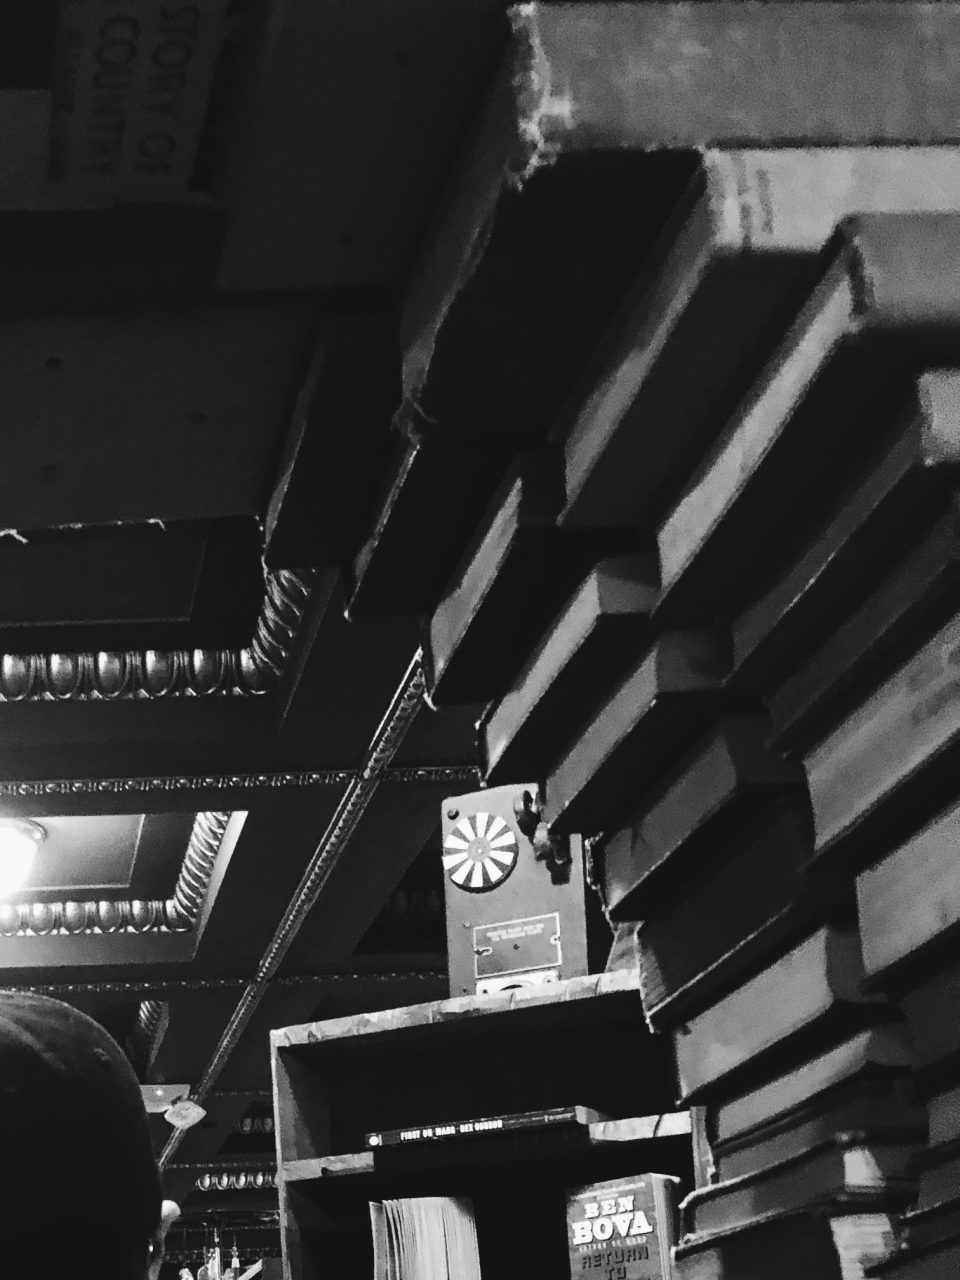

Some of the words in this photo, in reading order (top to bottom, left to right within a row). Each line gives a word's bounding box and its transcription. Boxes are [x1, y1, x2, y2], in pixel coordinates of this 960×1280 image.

[584, 1196, 635, 1219] BEN
[572, 1210, 654, 1246] BOVA
[582, 1246, 649, 1270] RETURN
